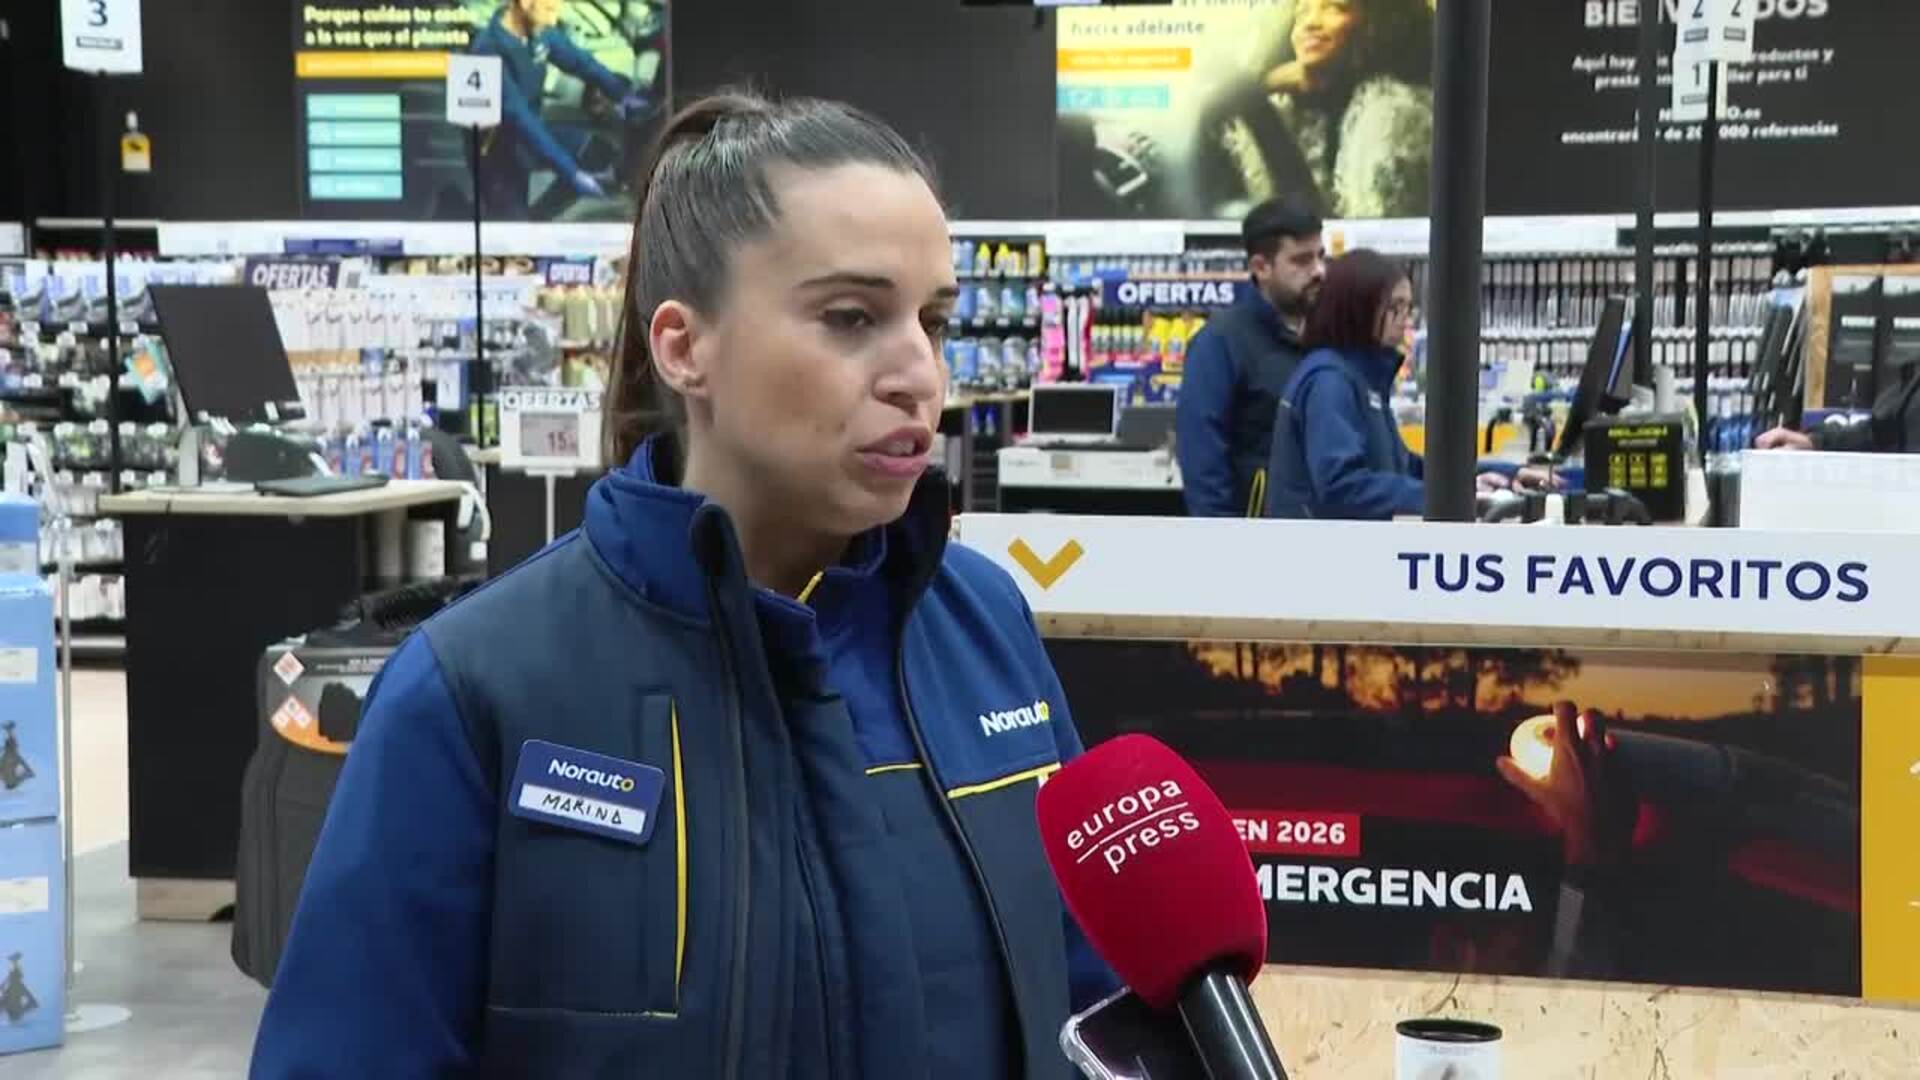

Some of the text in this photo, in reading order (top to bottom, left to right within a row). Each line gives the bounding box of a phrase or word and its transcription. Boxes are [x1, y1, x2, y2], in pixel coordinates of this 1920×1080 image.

[87, 0, 109, 27] 3
[303, 5, 361, 27] Porque
[363, 31, 392, 48] que
[412, 28, 469, 48] planeta
[1124, 19, 1206, 36] adelante
[466, 71, 481, 91] 4
[1757, 69, 1791, 85] para
[251, 262, 330, 290] OFERTAS
[1117, 281, 1236, 304] OFERTAS
[504, 390, 601, 413] OFERTAS
[1397, 552, 1870, 602] TUS FAVORITOS
[548, 758, 635, 793] Norauto
[542, 793, 622, 825] MARINA
[1066, 779, 1183, 850] europa
[1103, 811, 1201, 875] press
[1276, 820, 1346, 844] 2026
